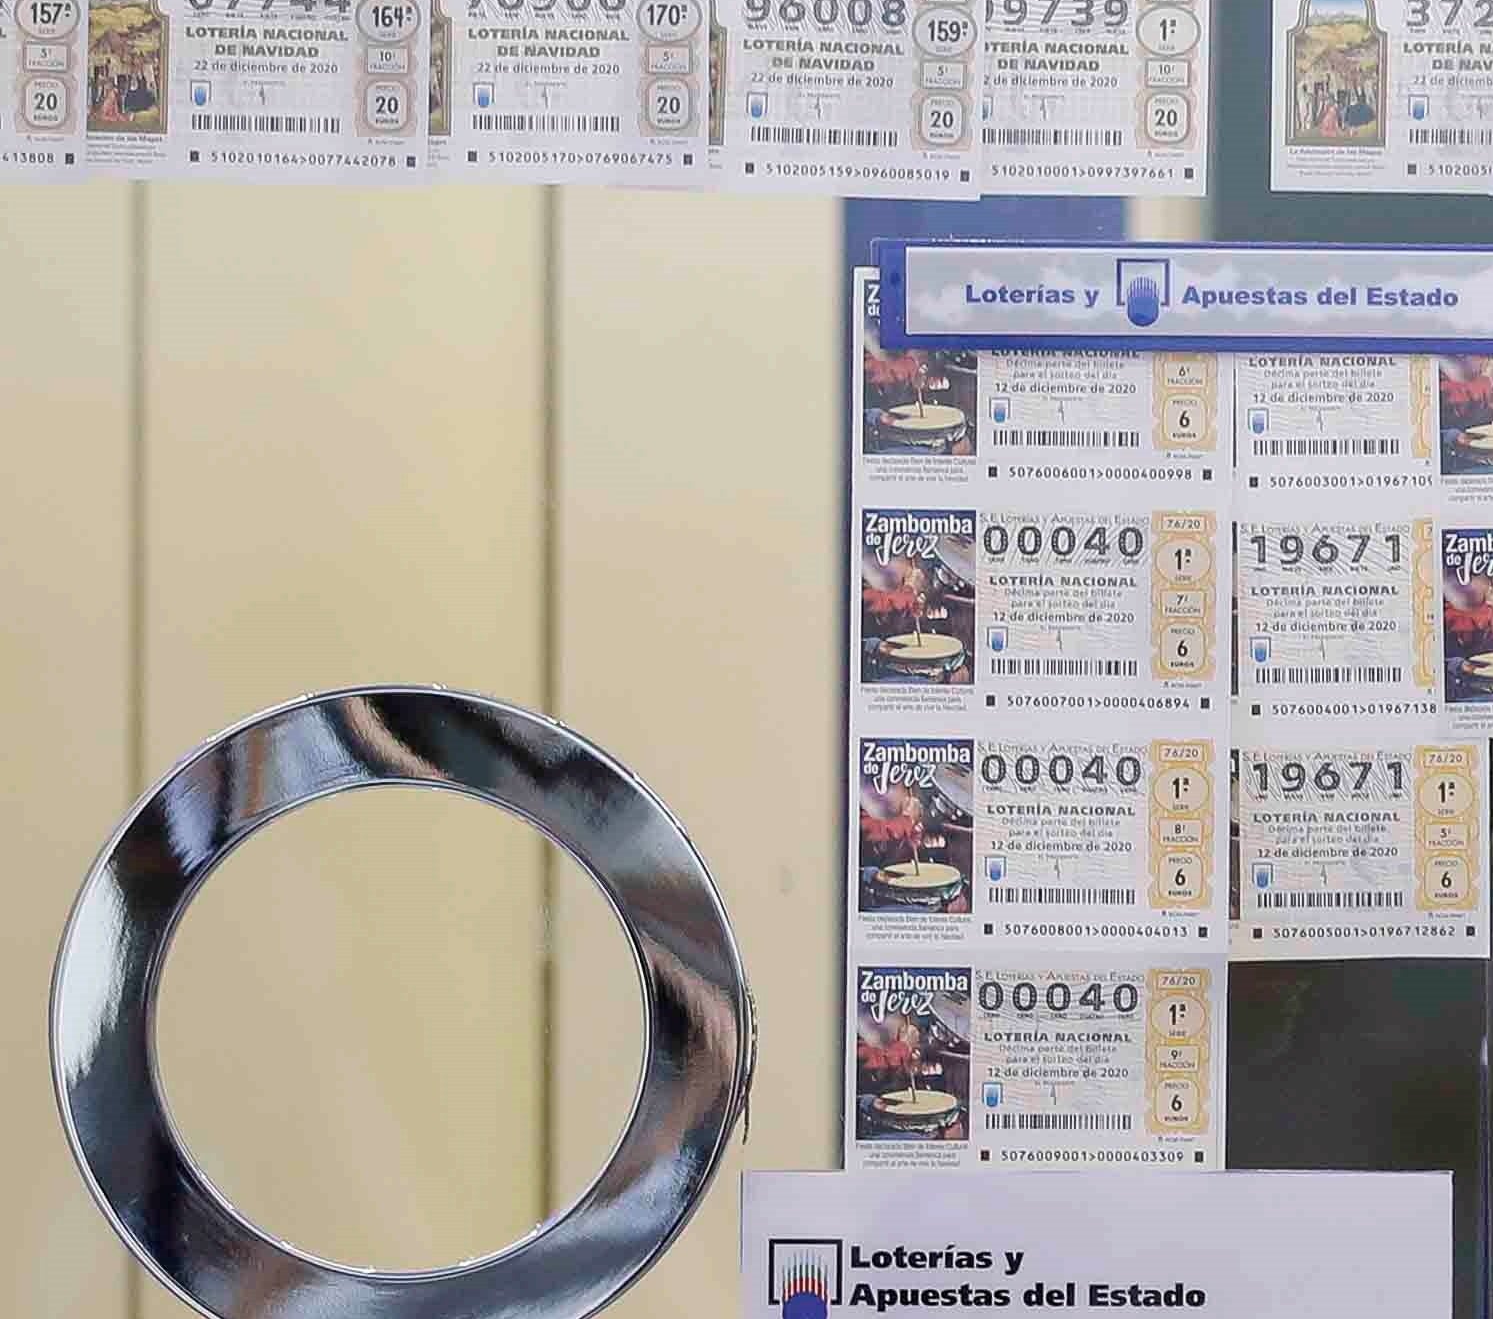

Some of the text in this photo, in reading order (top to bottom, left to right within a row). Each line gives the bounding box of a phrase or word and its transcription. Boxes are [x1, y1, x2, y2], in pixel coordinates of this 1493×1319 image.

[965, 284, 1459, 309] Loterías y Apuestas del Estado
[983, 525, 1144, 558] 00040
[1248, 530, 1402, 565] 19671
[978, 754, 1142, 786] 00040
[986, 802, 1136, 817] LOTERÍA NACIONAL
[991, 840, 1132, 853] 12 de diciembre de 2020
[1174, 867, 1186, 886] 6
[850, 1244, 1025, 1276] Loterías y
[849, 1282, 1206, 1313] Apuestas del Estado
